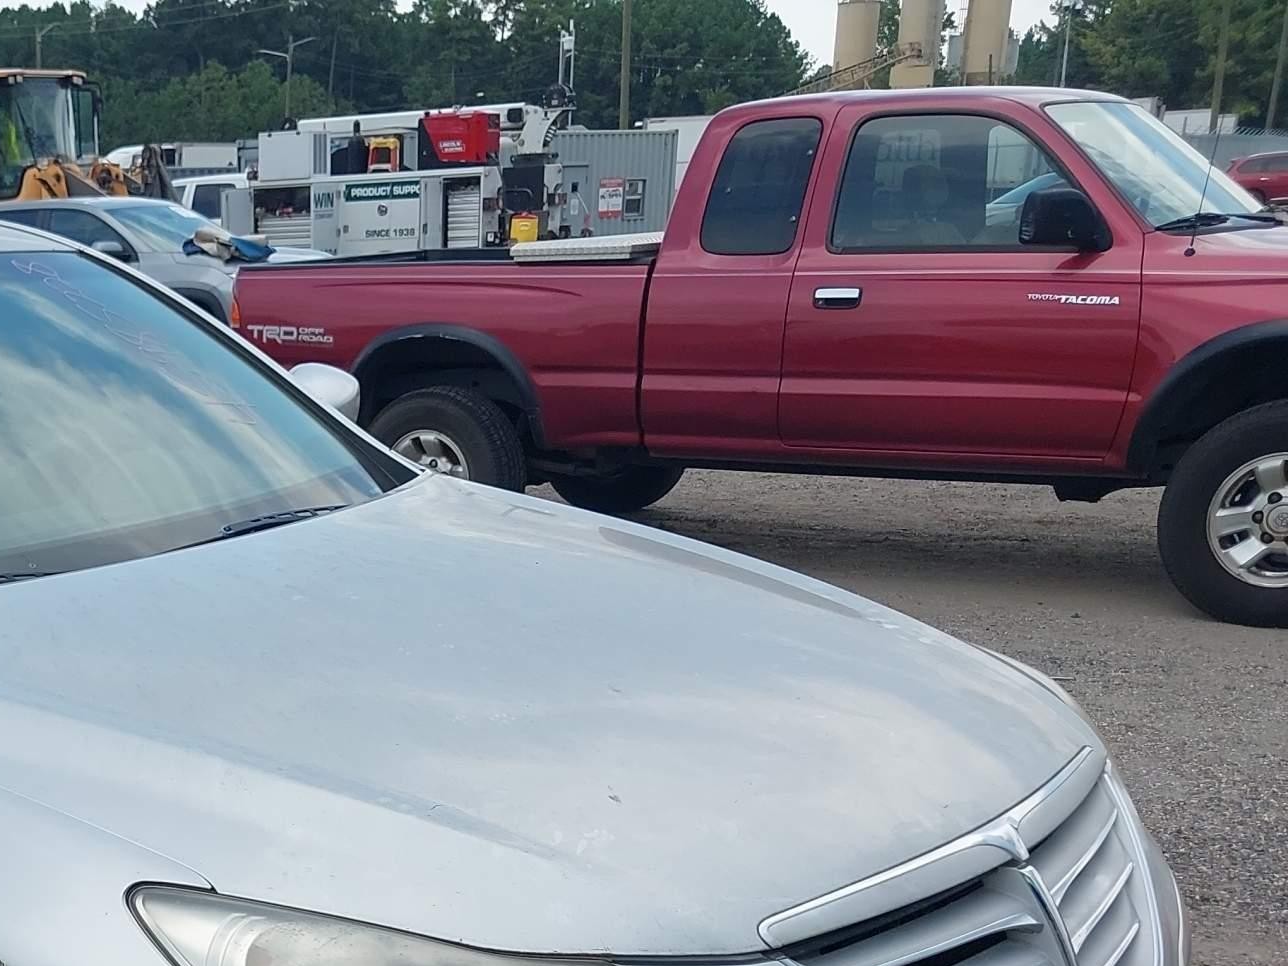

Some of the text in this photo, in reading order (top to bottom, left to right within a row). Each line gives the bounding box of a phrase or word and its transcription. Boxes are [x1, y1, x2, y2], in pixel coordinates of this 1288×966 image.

[351, 186, 390, 198] PRODUCT
[313, 192, 334, 209] WIN
[365, 228, 416, 238] SINCE 1938
[1026, 293, 1120, 305] TOYOTA TACOMA
[246, 324, 298, 345] TRD
[298, 334, 334, 343] ROAD
